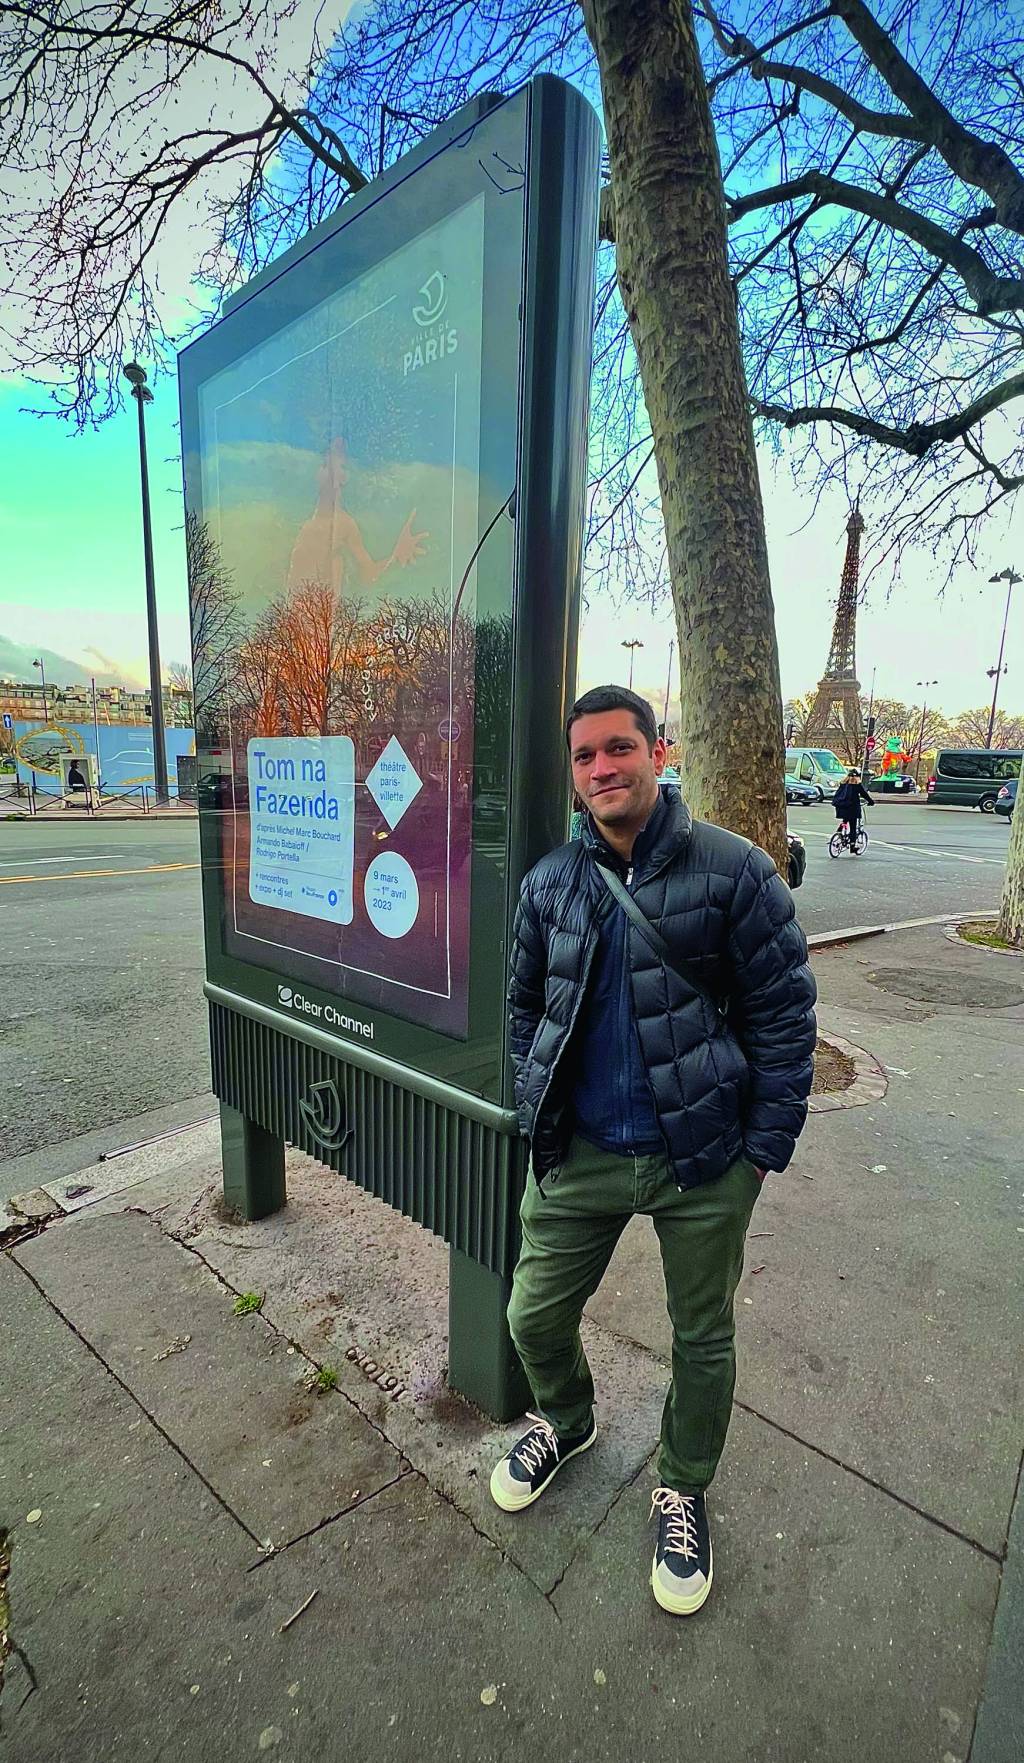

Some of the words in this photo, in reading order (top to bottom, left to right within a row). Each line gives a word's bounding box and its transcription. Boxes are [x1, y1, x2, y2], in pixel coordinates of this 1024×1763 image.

[403, 328, 458, 376] PARIS
[253, 751, 295, 780] Tom
[302, 759, 326, 782] na
[380, 761, 406, 772] théâtre
[380, 776, 401, 788] paris-
[256, 785, 339, 820] Fazenda
[380, 790, 404, 802] villette
[276, 824, 295, 836] Michel
[296, 827, 311, 838] Marc
[312, 829, 341, 842] Bouchard
[256, 836, 280, 847] Armando
[256, 847, 276, 860] Rodrigo
[260, 872, 289, 885] rencontres
[373, 870, 379, 880] 9
[380, 873, 399, 884] mars
[390, 889, 407, 900] avril
[372, 898, 392, 911] 2023
[293, 993, 322, 1017] Clear
[324, 1006, 374, 1039] Channel
